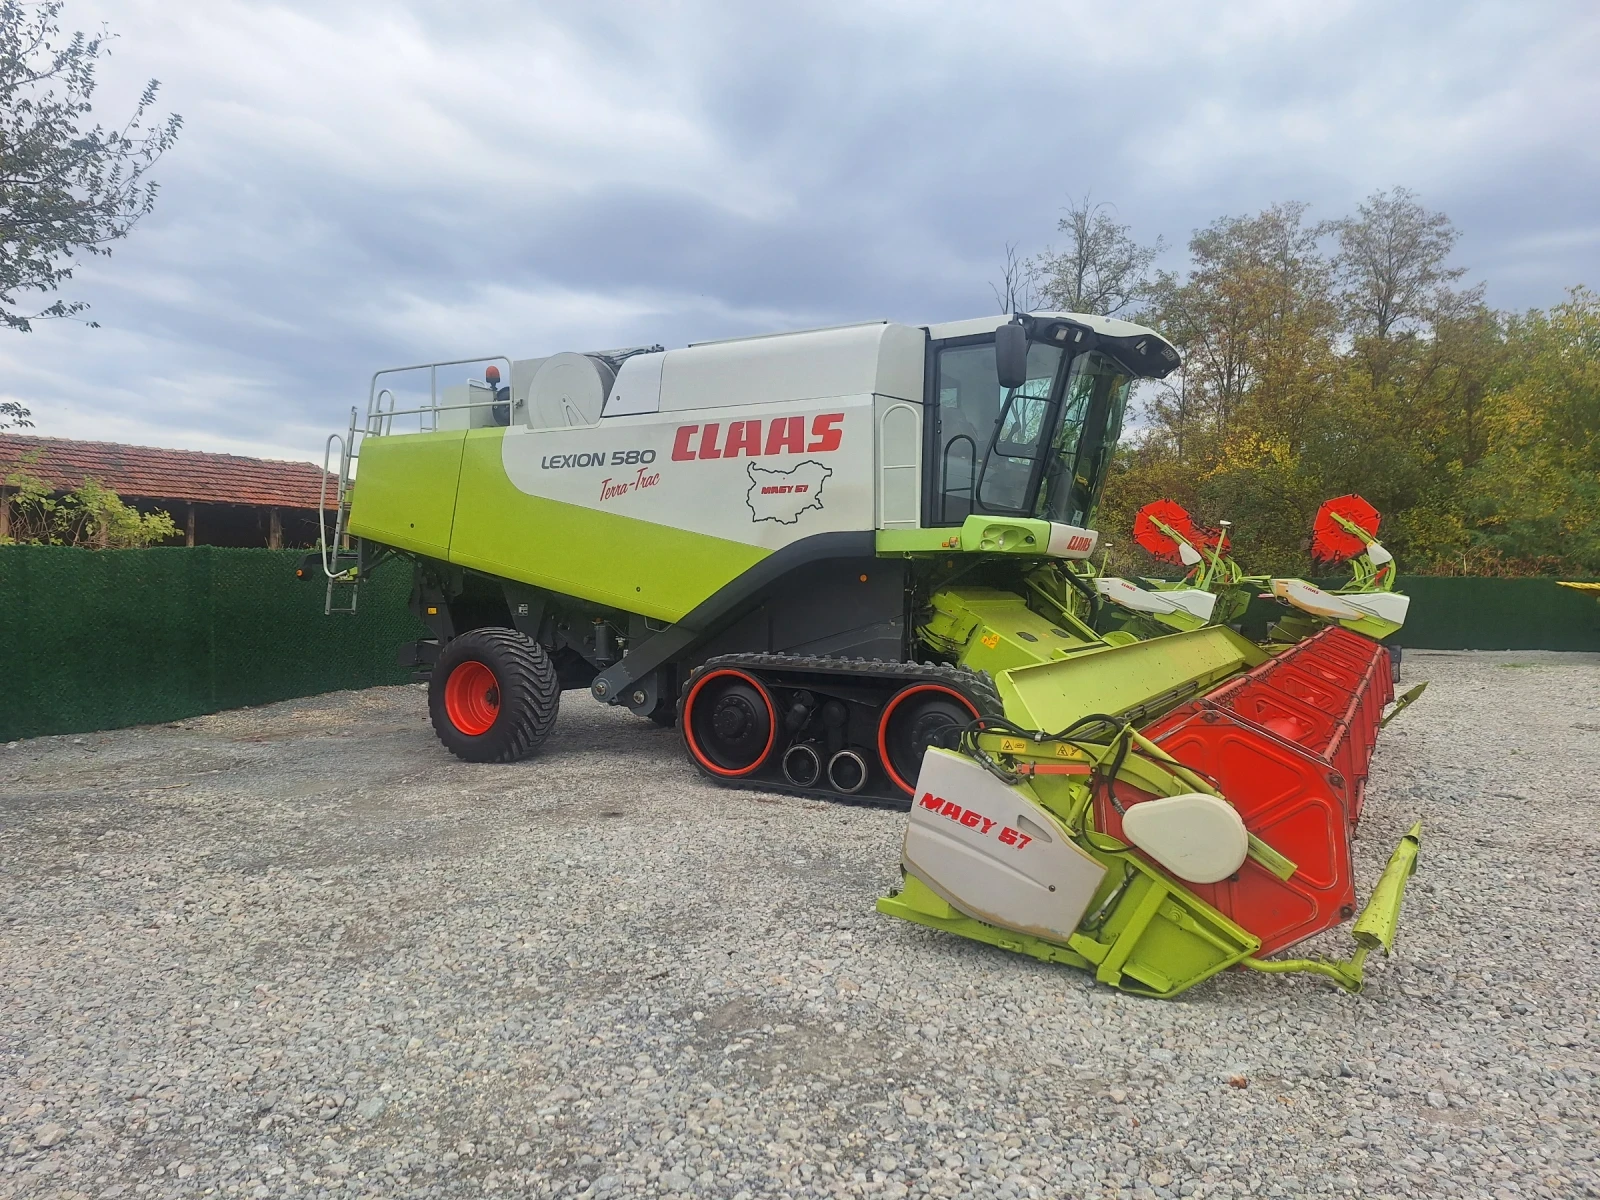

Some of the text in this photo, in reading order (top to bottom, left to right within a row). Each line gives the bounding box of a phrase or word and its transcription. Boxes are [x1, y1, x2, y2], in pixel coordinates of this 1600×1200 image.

[671, 413, 845, 461] CLAAS
[541, 449, 656, 469] LEXION 580
[599, 466, 660, 502] Terra-Trac
[1066, 535, 1092, 551] CLAAS
[919, 792, 997, 834] MAGY
